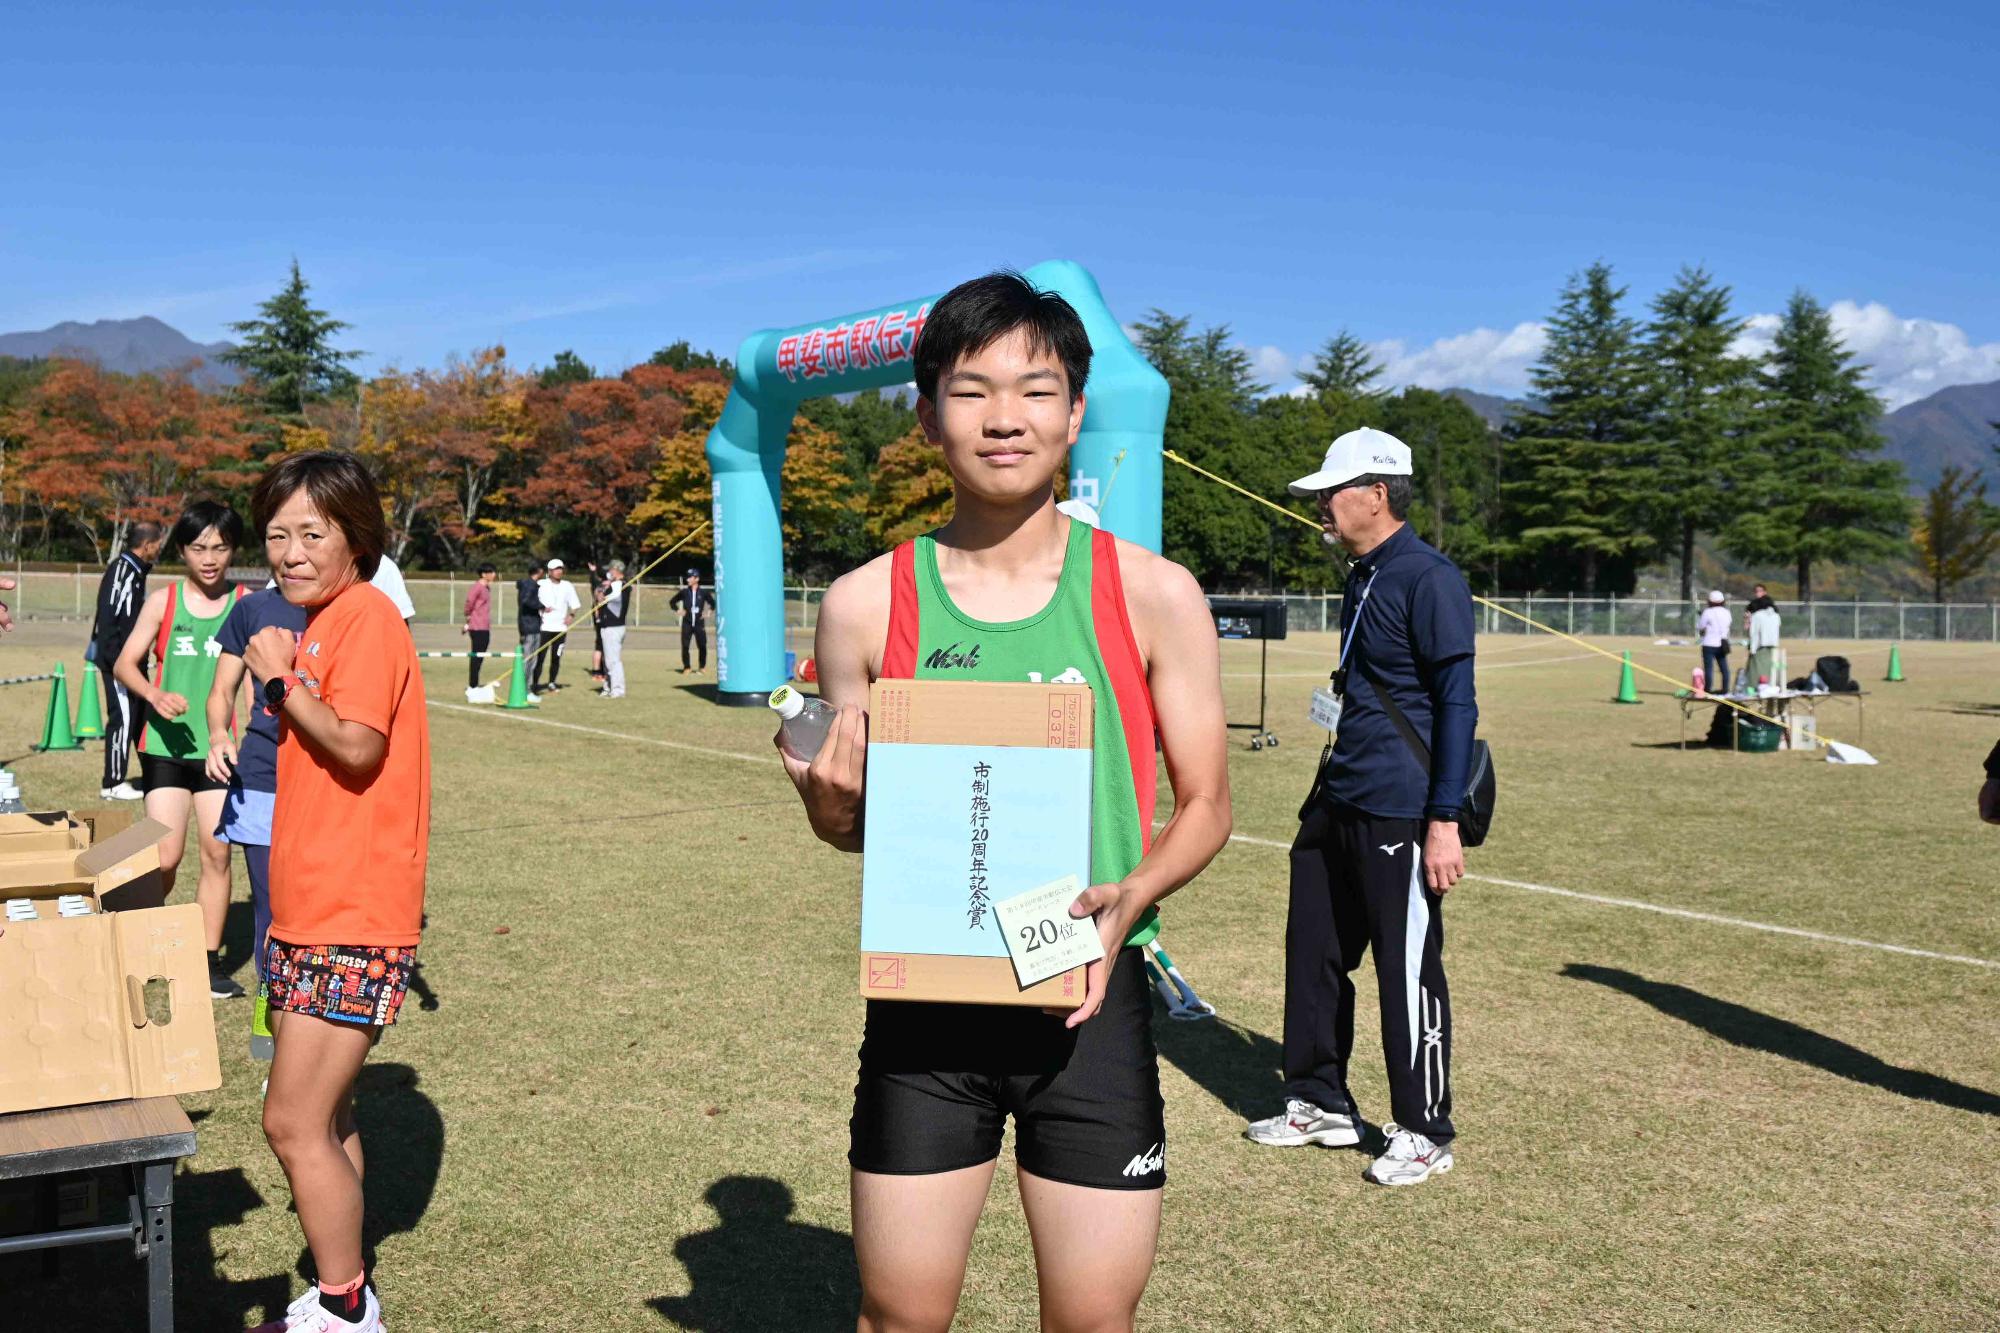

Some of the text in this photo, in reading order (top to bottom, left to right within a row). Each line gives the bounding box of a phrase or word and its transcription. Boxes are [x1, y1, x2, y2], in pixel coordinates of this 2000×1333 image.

[967, 761, 992, 931] 市制施行20周年記念賞
[1020, 918, 1078, 953] 20位
